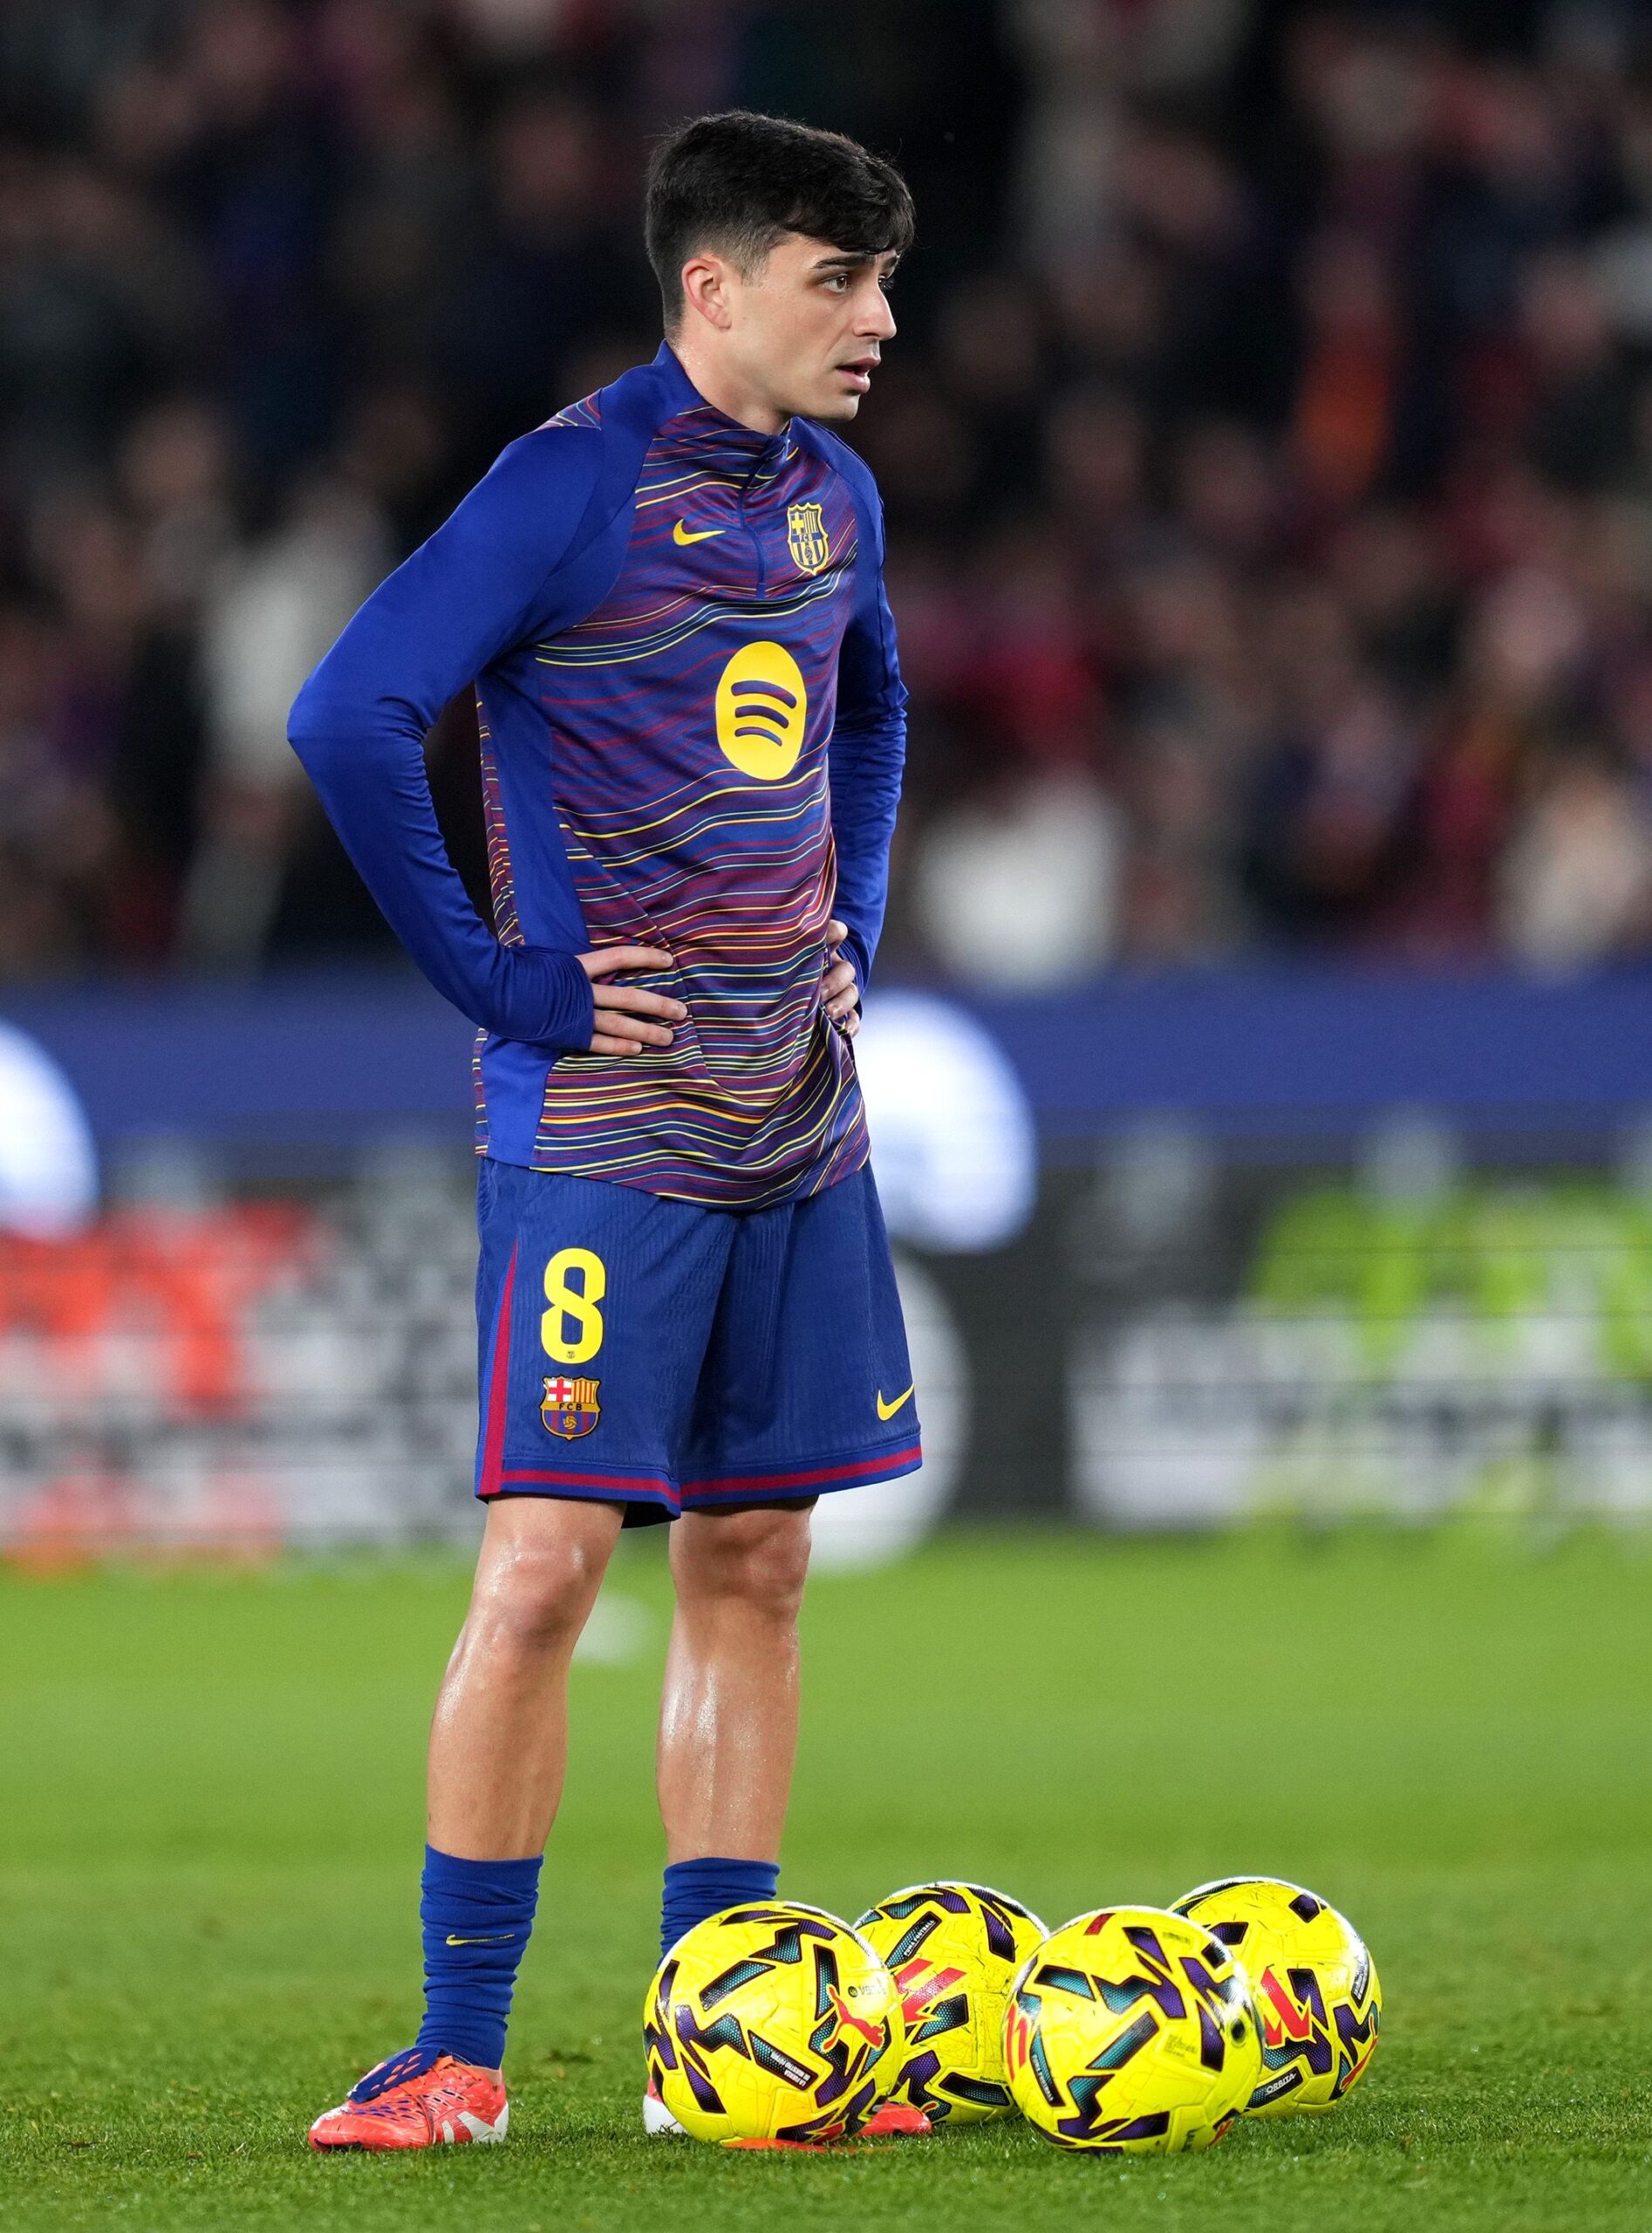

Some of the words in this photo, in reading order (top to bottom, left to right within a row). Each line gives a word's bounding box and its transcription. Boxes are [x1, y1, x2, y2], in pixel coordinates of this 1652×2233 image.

[799, 533, 813, 543] FCB
[541, 1247, 606, 1364] 8
[558, 1403, 583, 1411] FCB
[903, 1941, 916, 1956] PUMA
[913, 1920, 935, 1942] FOOTBALL
[1265, 2073, 1297, 2095] ORBITA
